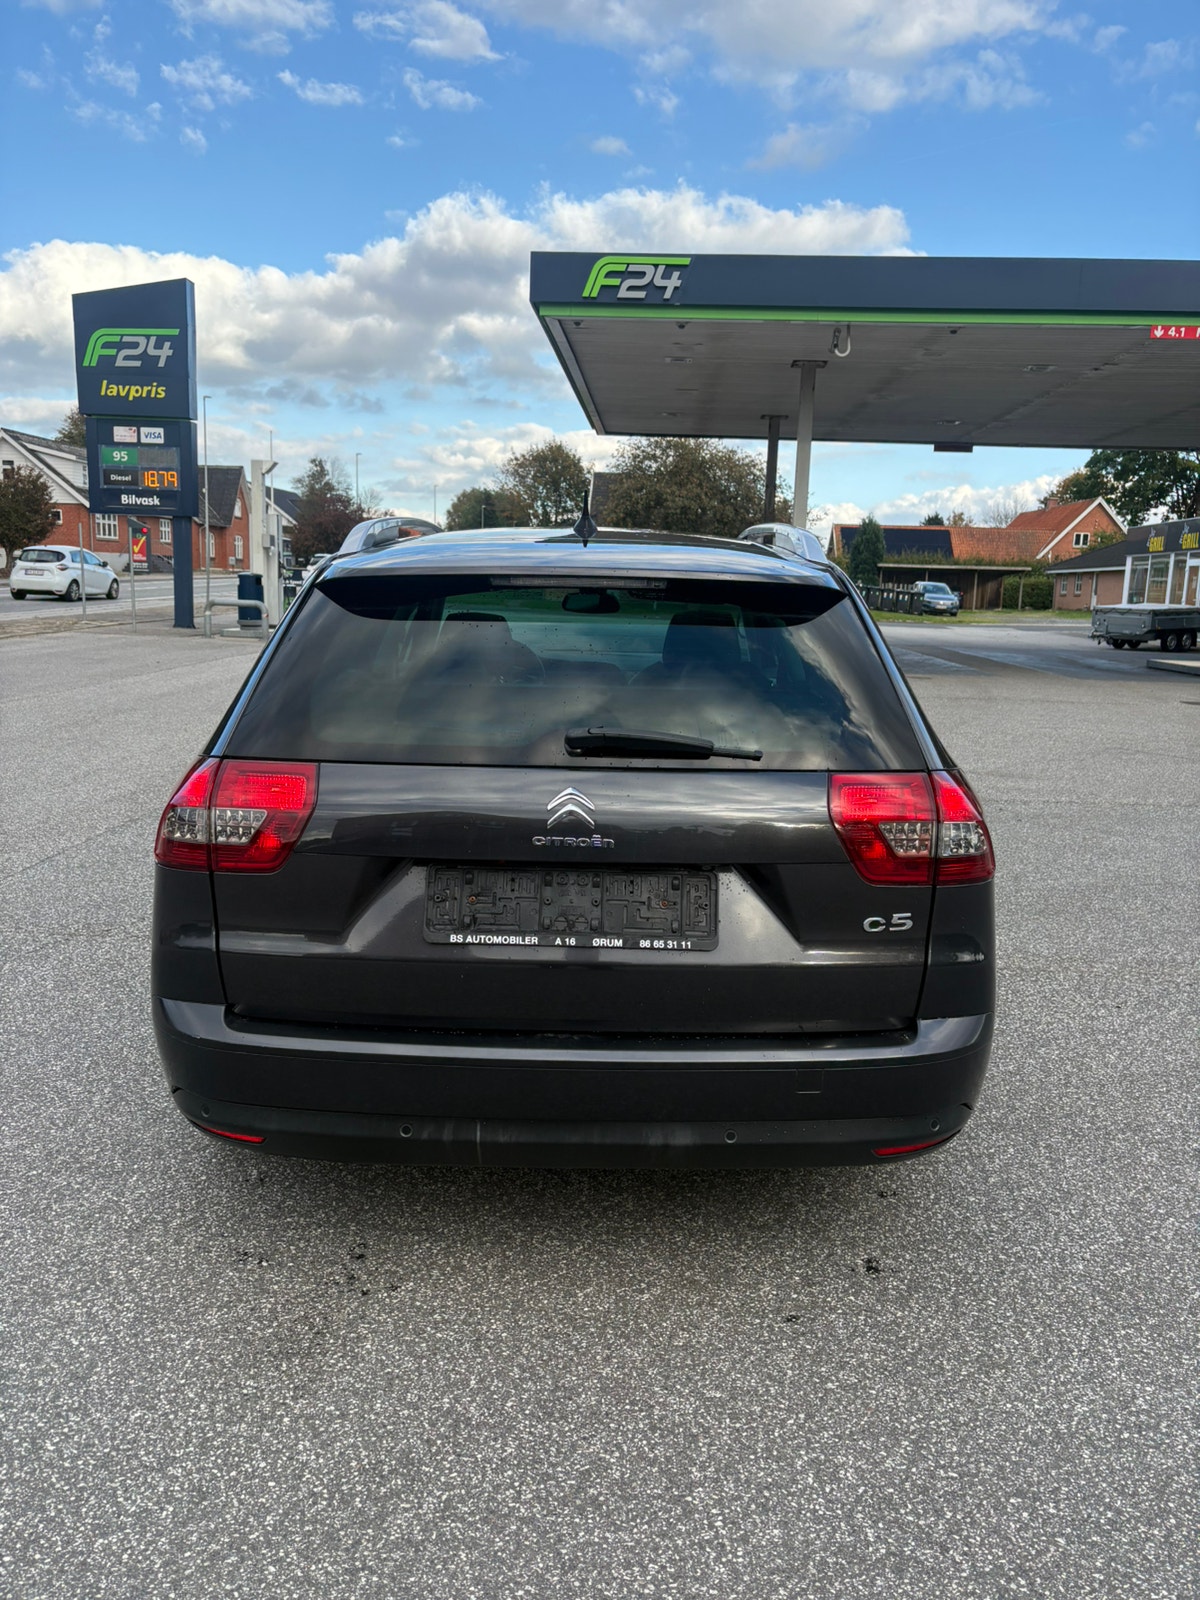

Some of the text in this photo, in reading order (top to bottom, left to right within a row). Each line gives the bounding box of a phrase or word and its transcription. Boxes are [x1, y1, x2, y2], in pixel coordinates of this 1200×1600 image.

[582, 255, 691, 300] F24
[1168, 326, 1185, 338] 4.1
[82, 328, 180, 367] F24
[100, 380, 166, 401] lavpris
[143, 431, 163, 439] VISA
[112, 450, 129, 462] 95
[121, 494, 160, 506] Bilvask
[1182, 531, 1199, 550] GRILL
[449, 934, 691, 949] BS AUTOMOBILER A 16 ØRUM 86 65 31 11
